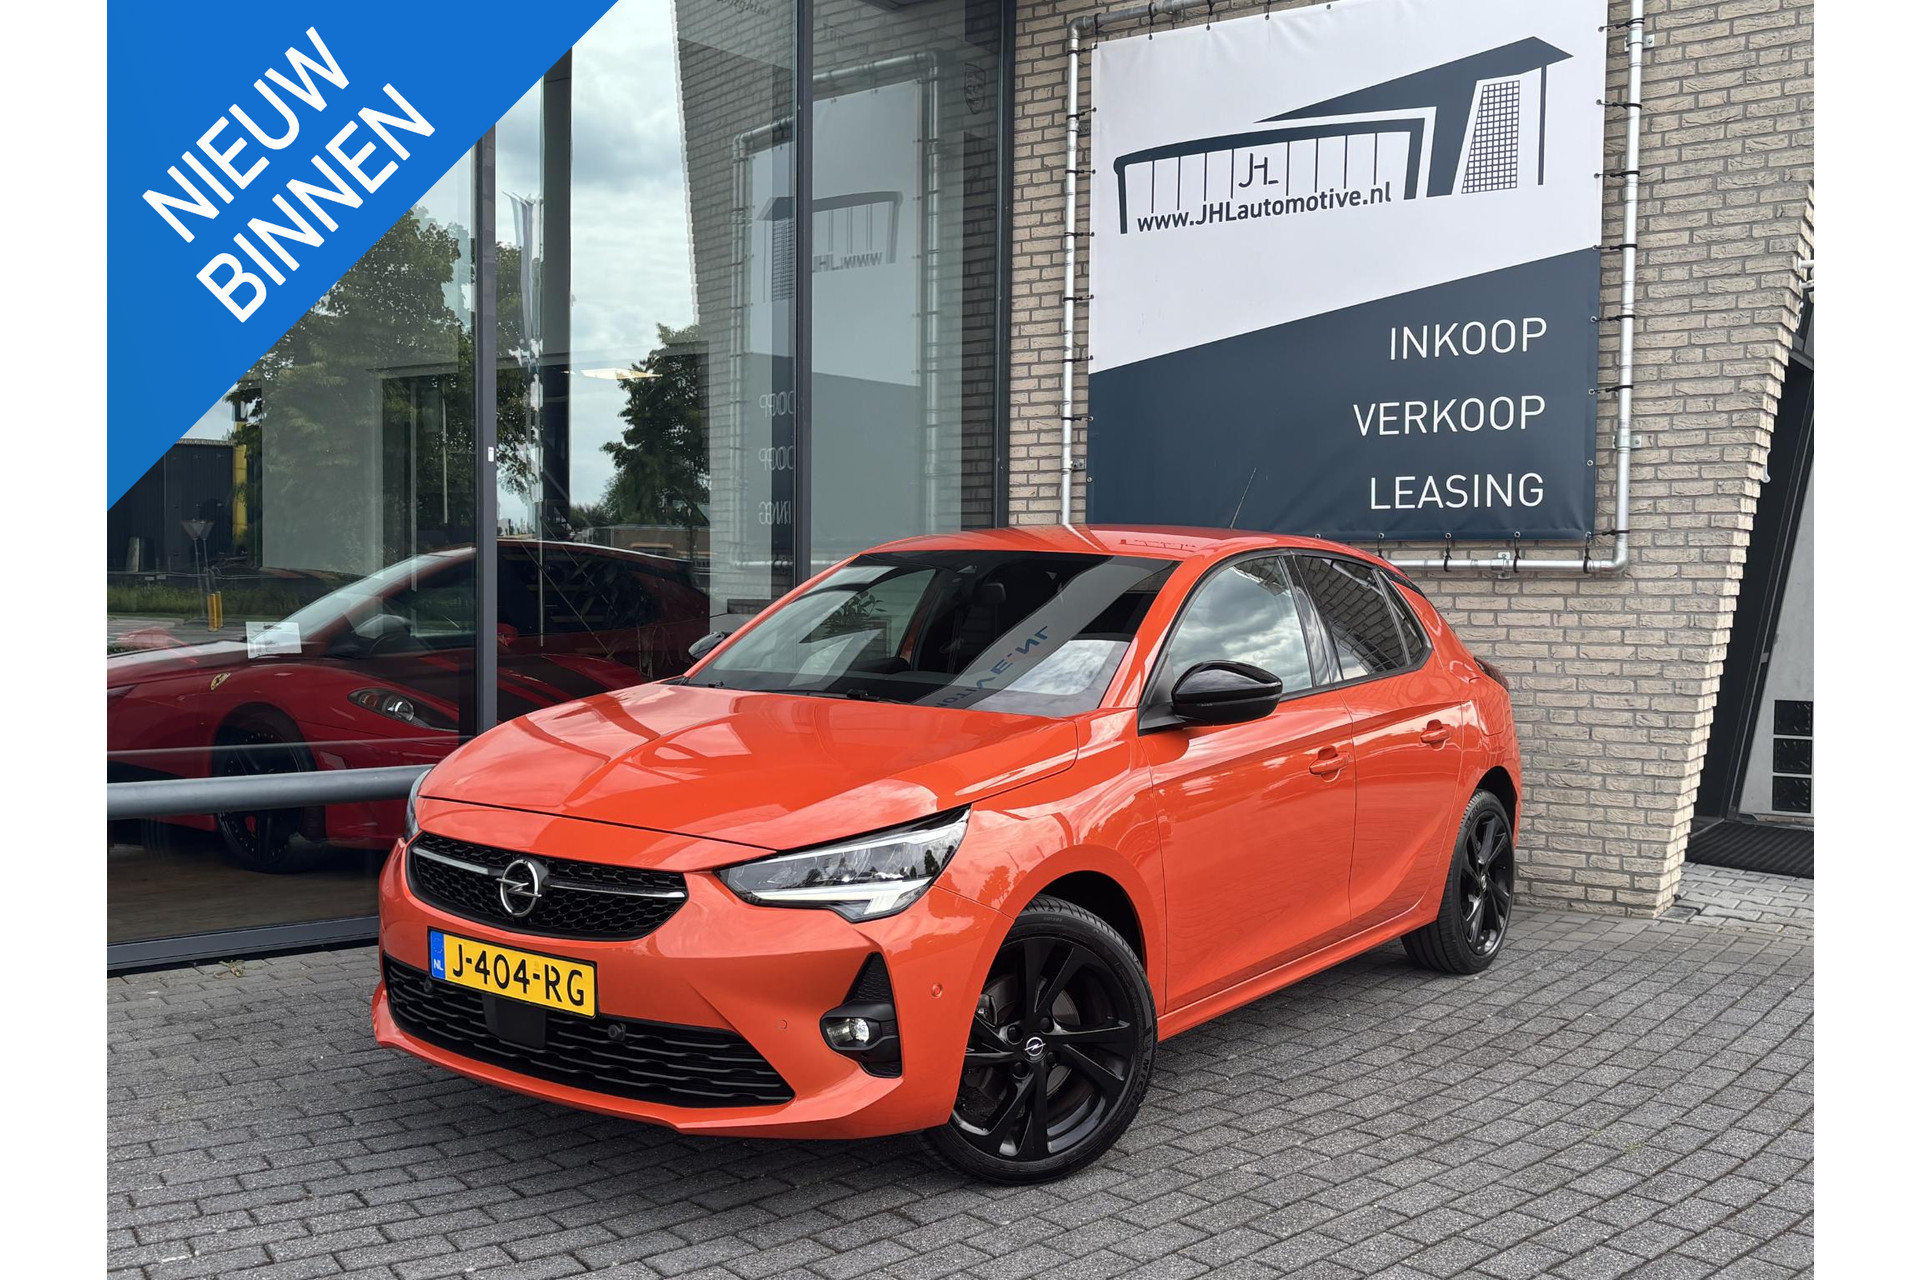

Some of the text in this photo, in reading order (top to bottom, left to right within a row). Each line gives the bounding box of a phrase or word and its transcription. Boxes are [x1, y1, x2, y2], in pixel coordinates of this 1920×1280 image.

[1238, 152, 1280, 189] JHL
[1136, 180, 1392, 233] www.JHLautomotive.nl
[1390, 316, 1548, 361] INKOOP
[1352, 394, 1546, 437] VERKOOP
[1370, 472, 1544, 510] LEASING
[432, 958, 445, 972] NL
[452, 943, 586, 1007] J-404-RG
